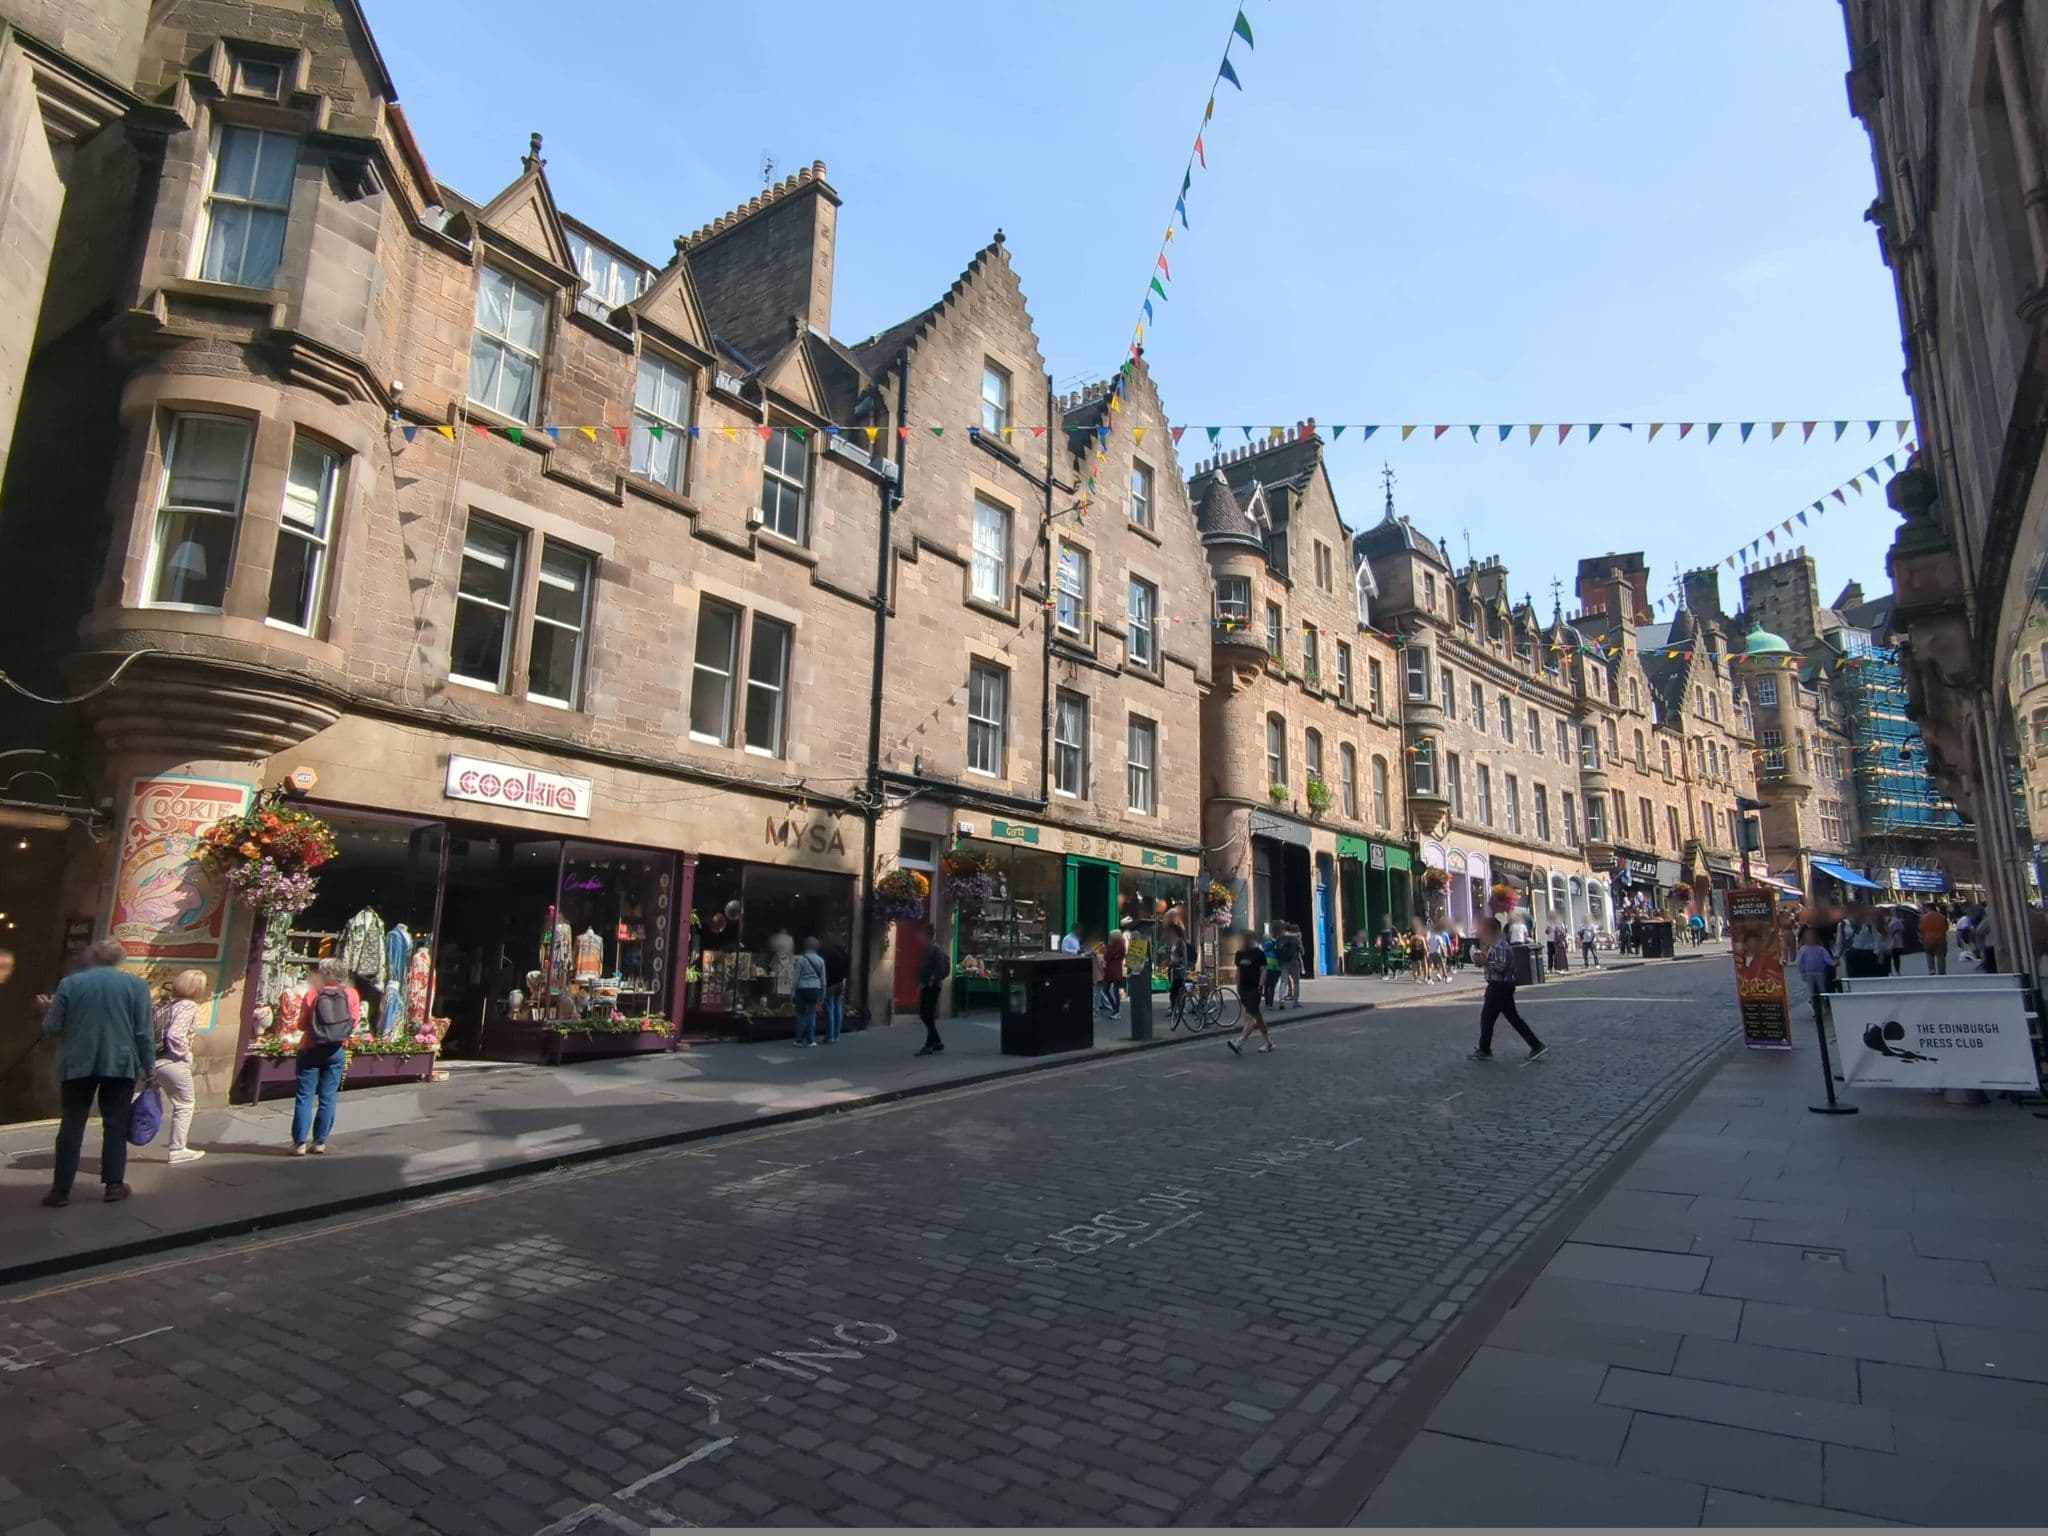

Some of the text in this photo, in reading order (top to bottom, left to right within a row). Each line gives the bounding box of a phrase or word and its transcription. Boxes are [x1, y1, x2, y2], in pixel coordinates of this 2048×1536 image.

[460, 770, 576, 810] cookie
[765, 815, 845, 857] MYSA
[1006, 827, 1025, 837] GIFTS
[1061, 831, 1124, 862] EDEN
[1916, 1023, 2000, 1034] THE EDINBURGH
[1920, 1039, 1984, 1048] PRESS CLUB
